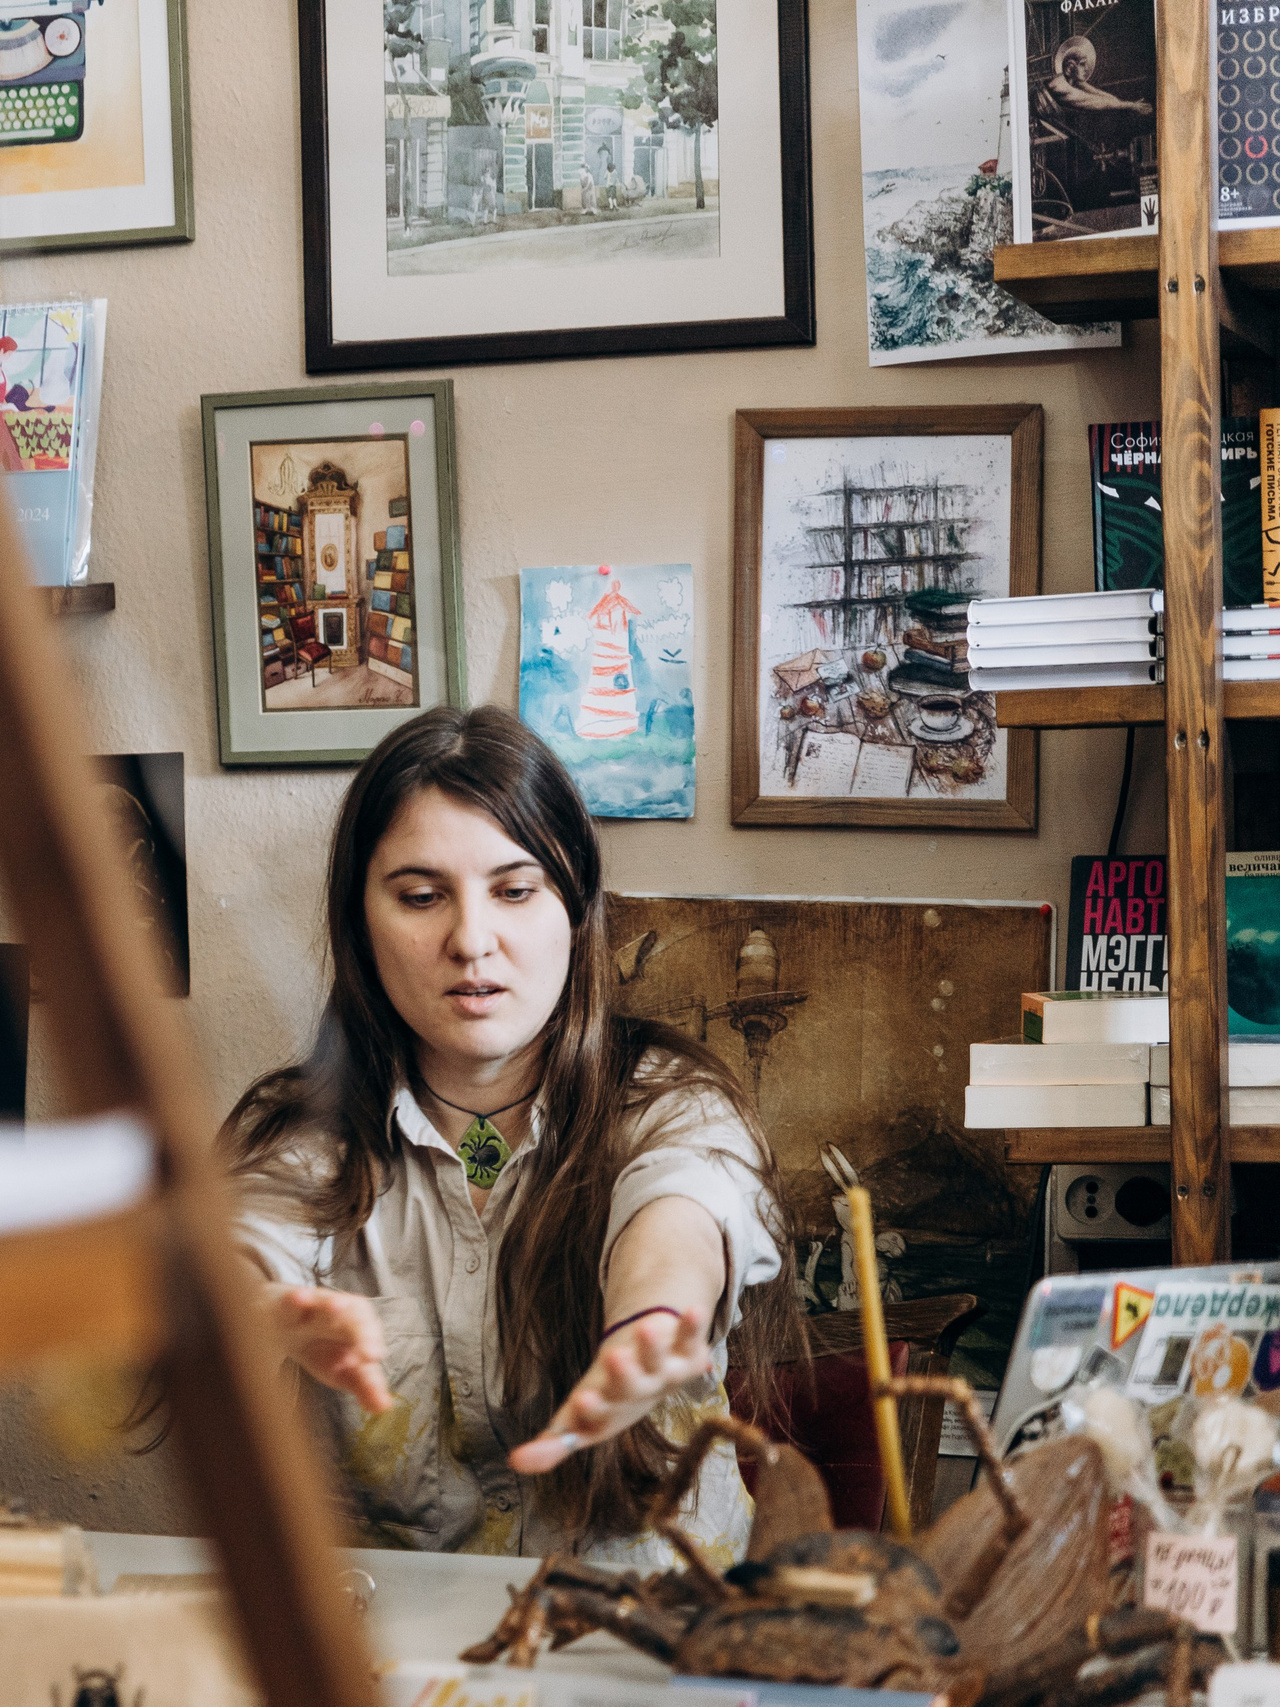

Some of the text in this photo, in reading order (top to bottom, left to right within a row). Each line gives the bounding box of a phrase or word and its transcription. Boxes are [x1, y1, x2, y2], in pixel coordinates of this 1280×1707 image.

[1060, 0, 1119, 13] ФАКА
[1221, 5, 1280, 26] ИЗБР
[1111, 432, 1161, 451] Софи
[1221, 448, 1258, 461] ИРЬ
[1265, 423, 1276, 521] ГОТСКИЕ ПИСЬМА
[17, 507, 50, 521] 2024
[1086, 861, 1163, 897] АРГО
[1083, 898, 1166, 934] НАВТ
